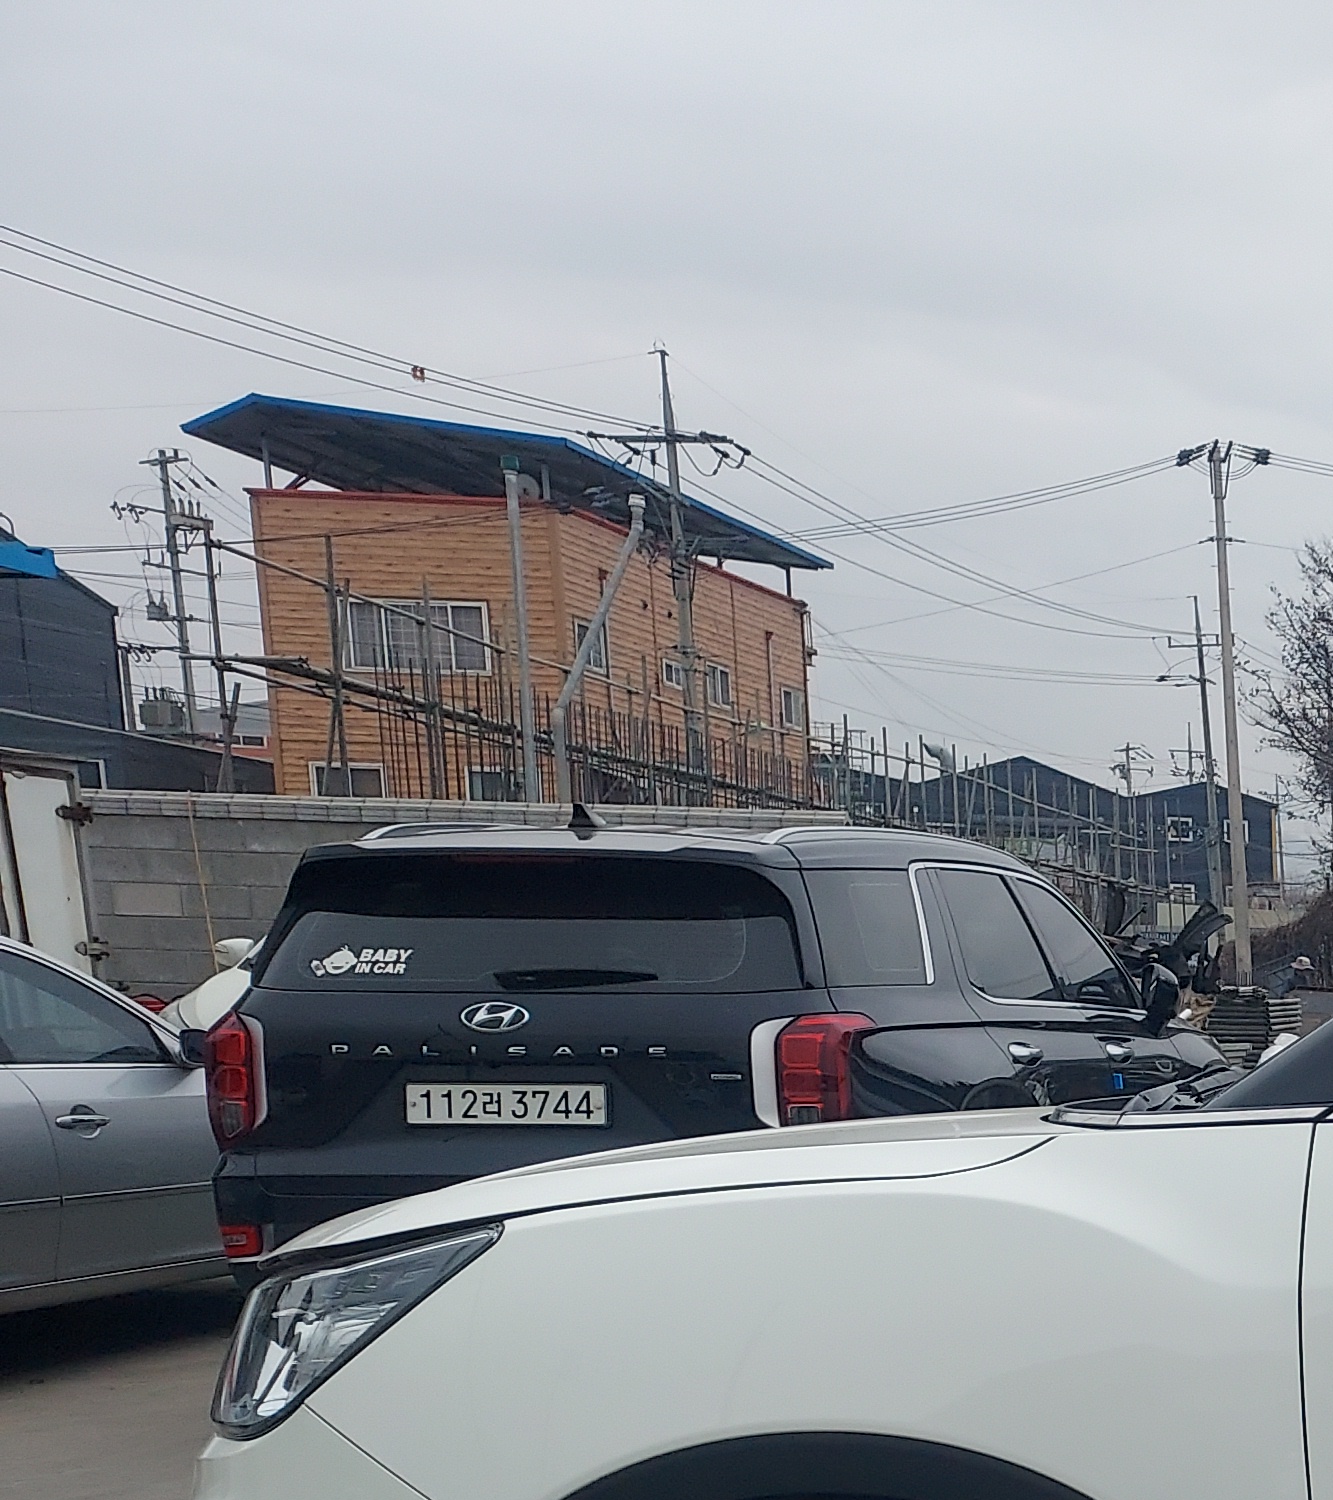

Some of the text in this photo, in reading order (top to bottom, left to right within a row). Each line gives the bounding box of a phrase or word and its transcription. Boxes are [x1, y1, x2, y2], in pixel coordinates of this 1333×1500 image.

[359, 949, 413, 961] BABY
[355, 963, 406, 974] IN CAR
[331, 1044, 667, 1058] PALISADE
[419, 1089, 594, 1120] 112러 3744
